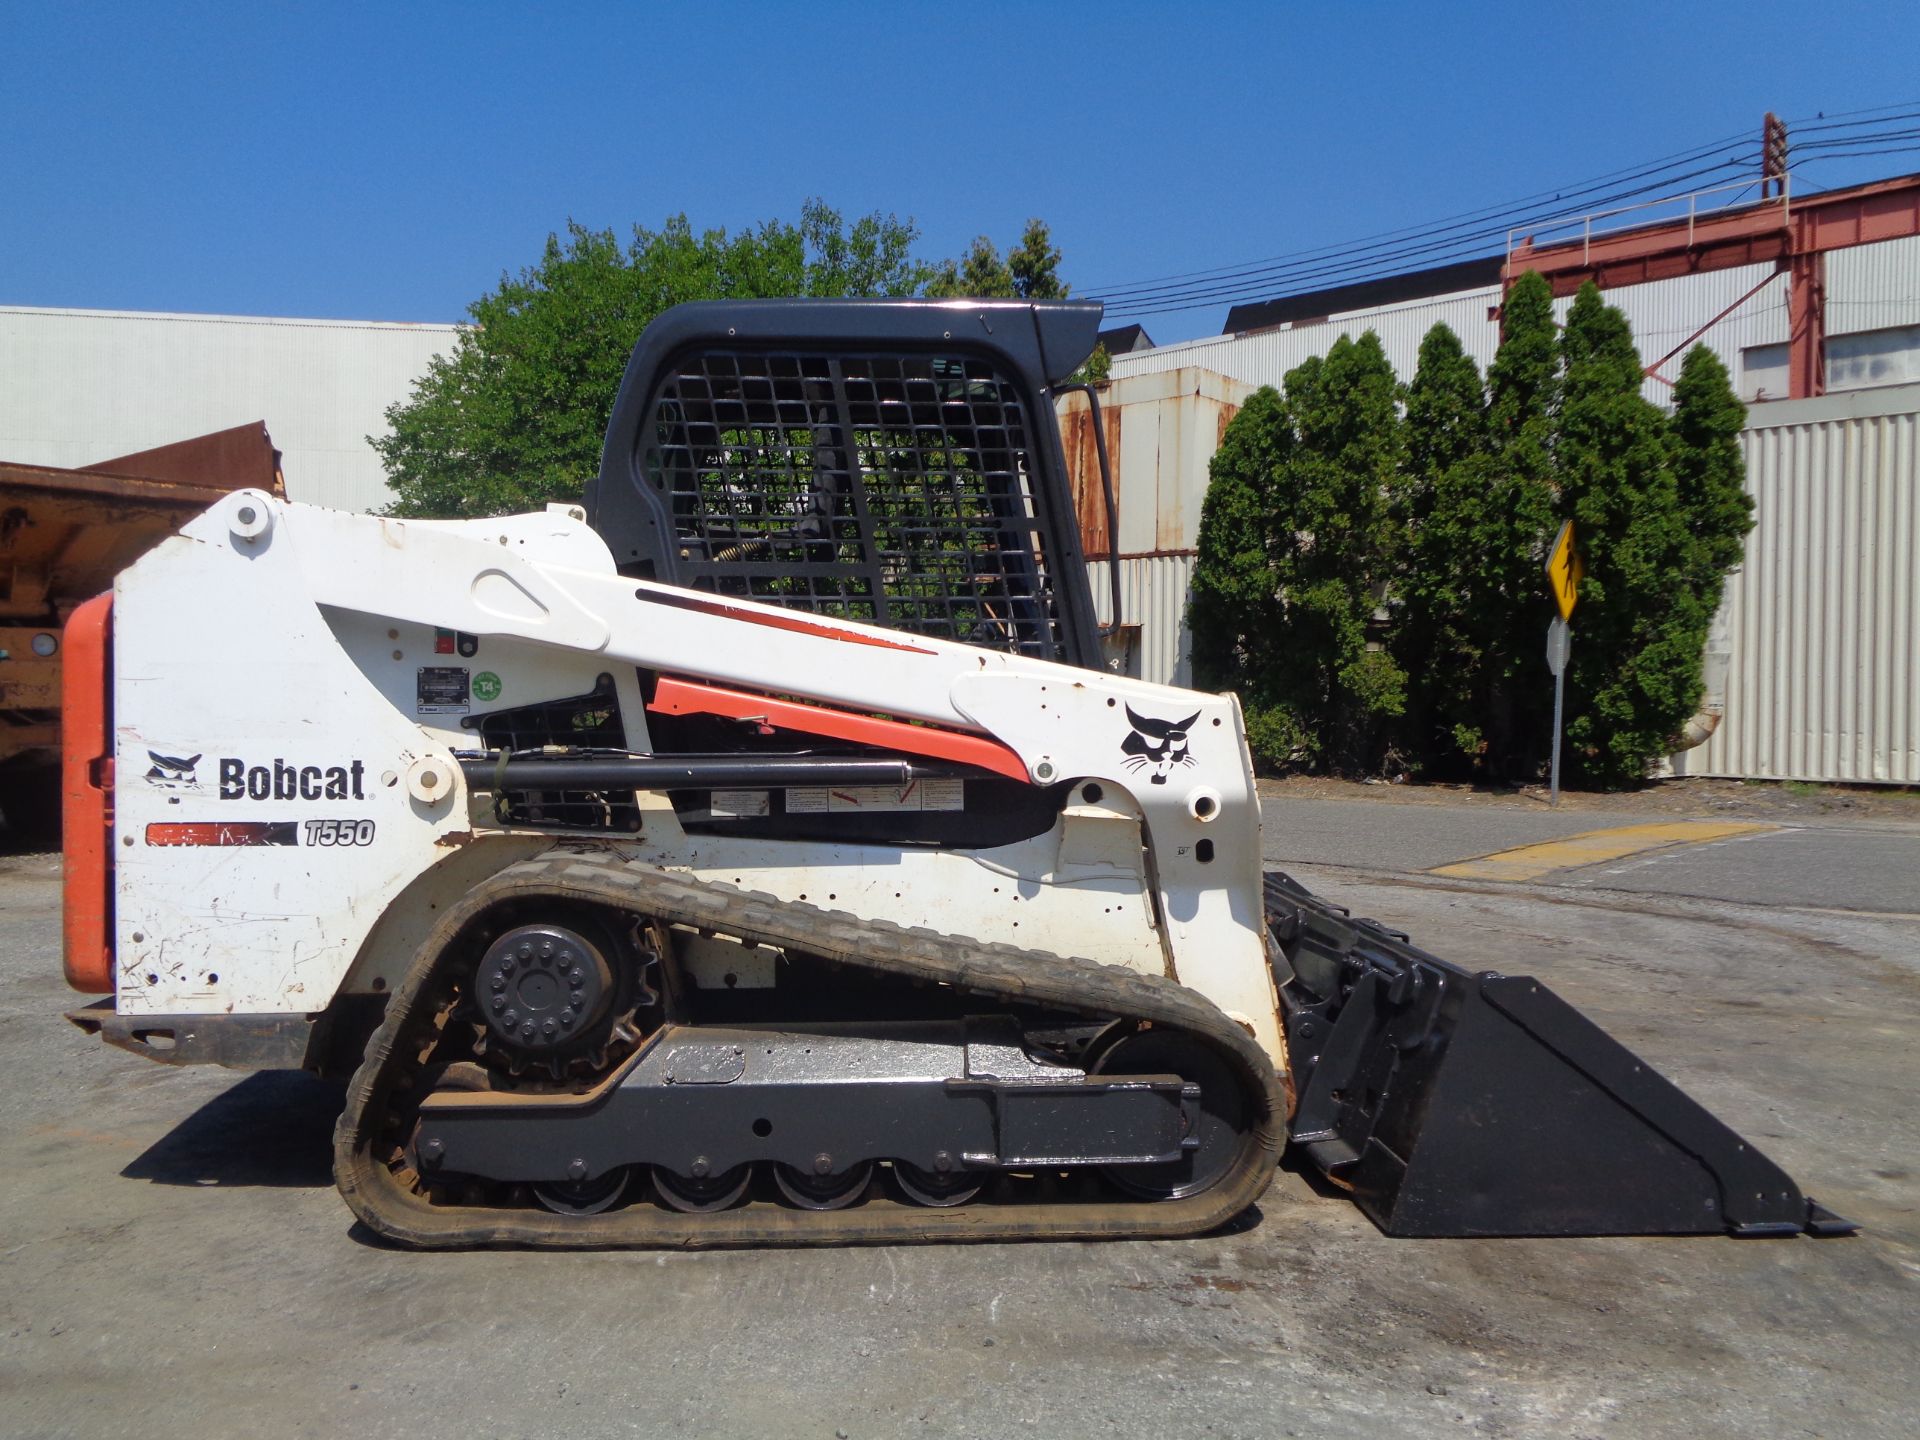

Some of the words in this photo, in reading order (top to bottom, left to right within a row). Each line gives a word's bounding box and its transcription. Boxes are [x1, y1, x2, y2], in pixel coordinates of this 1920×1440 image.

[480, 681, 494, 692] T4
[220, 758, 365, 801] Bobcat
[305, 819, 376, 847] T550
